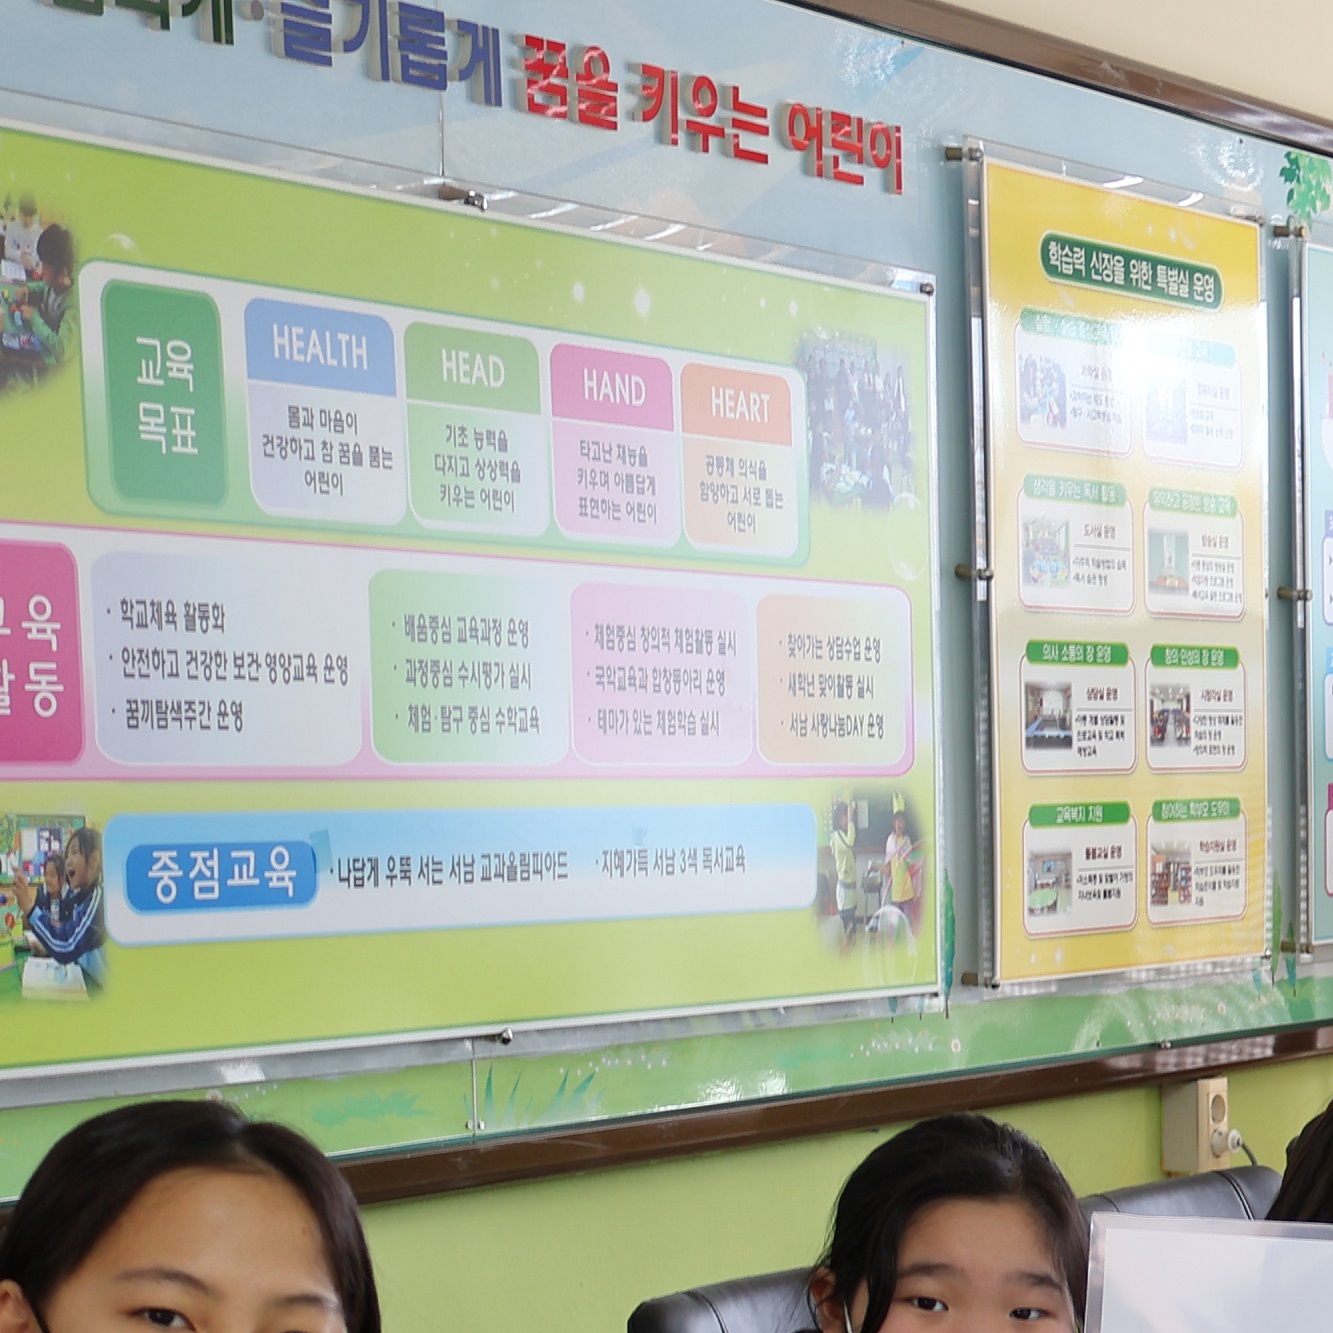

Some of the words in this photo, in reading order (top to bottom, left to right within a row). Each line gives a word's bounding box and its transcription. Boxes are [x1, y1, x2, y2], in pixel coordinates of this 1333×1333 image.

[516, 34, 618, 131] 꿈을
[630, 63, 770, 165] 키우는
[785, 100, 903, 195] 어린이
[1049, 241, 1086, 278] 학습력
[1090, 249, 1125, 286] 신장을
[1129, 259, 1153, 291] 위한
[1156, 265, 1190, 298] 특별실
[1193, 272, 1215, 303] 운영
[136, 335, 194, 393] 교육
[272, 322, 368, 371] HEALTH
[441, 348, 506, 389] HEAD
[583, 367, 647, 408] HAND
[287, 404, 315, 432] 몸과
[319, 406, 359, 437] 마음이
[711, 386, 771, 425] HEART
[137, 401, 198, 455] 목표
[445, 424, 469, 449] 기초
[473, 427, 509, 454] 능력을
[262, 433, 316, 462] 건강하고
[321, 438, 334, 464] 참
[338, 441, 364, 468] 꿈을
[369, 444, 394, 471] 품는
[434, 453, 471, 479] 다지고
[475, 459, 521, 485] 상상력을
[579, 439, 613, 464] 타고난
[616, 444, 649, 469] 재능을
[705, 454, 735, 479] 공동체
[738, 457, 768, 482] 의식을
[304, 470, 344, 497] 어린이
[439, 484, 475, 510] 키우는
[480, 486, 516, 513] 어린이
[577, 467, 611, 493] 키우며
[614, 471, 657, 497] 아름답게
[578, 496, 622, 522] 표현하는
[625, 498, 658, 525] 어린이
[726, 513, 757, 535] 어린이
[0, 593, 62, 652] 육
[119, 596, 179, 633] 학교체육
[183, 599, 226, 635] 활동화
[404, 612, 452, 644] 배움중심
[456, 615, 503, 649] 교육과정
[507, 618, 530, 650] 운영
[594, 622, 638, 653] 체험중심
[640, 625, 672, 656] 창의적
[674, 627, 714, 657] 체험활동
[717, 630, 738, 657] 실시
[121, 645, 181, 681] 안전하고
[186, 649, 229, 683] 건강한
[233, 652, 263, 684] 보건
[264, 652, 319, 686] 영양교육
[323, 653, 350, 688] 운영
[404, 657, 454, 691] 과정중심
[457, 660, 506, 691] 수시평가
[509, 661, 532, 691] 실시
[125, 698, 213, 732] 꿈끼탐색주간
[216, 700, 245, 734] 운영
[467, 705, 491, 736] 중심
[495, 705, 541, 736] 수학교육
[597, 708, 630, 736] 테마가
[632, 709, 653, 737] 있는
[656, 710, 698, 737] 체험학습
[700, 711, 720, 737] 실시
[789, 713, 809, 739] 서남
[867, 714, 885, 740] 운영
[148, 845, 297, 904] 중점교육
[337, 856, 380, 890] 나답게
[385, 855, 413, 889] 우뚝
[417, 853, 444, 887] 서는
[449, 853, 477, 887] 서남
[480, 851, 569, 883] 교과올림피아드
[601, 846, 650, 879] 지혜가득
[653, 846, 676, 877] 서남
[679, 845, 699, 876] 3색
[702, 844, 746, 876] 독서교육
